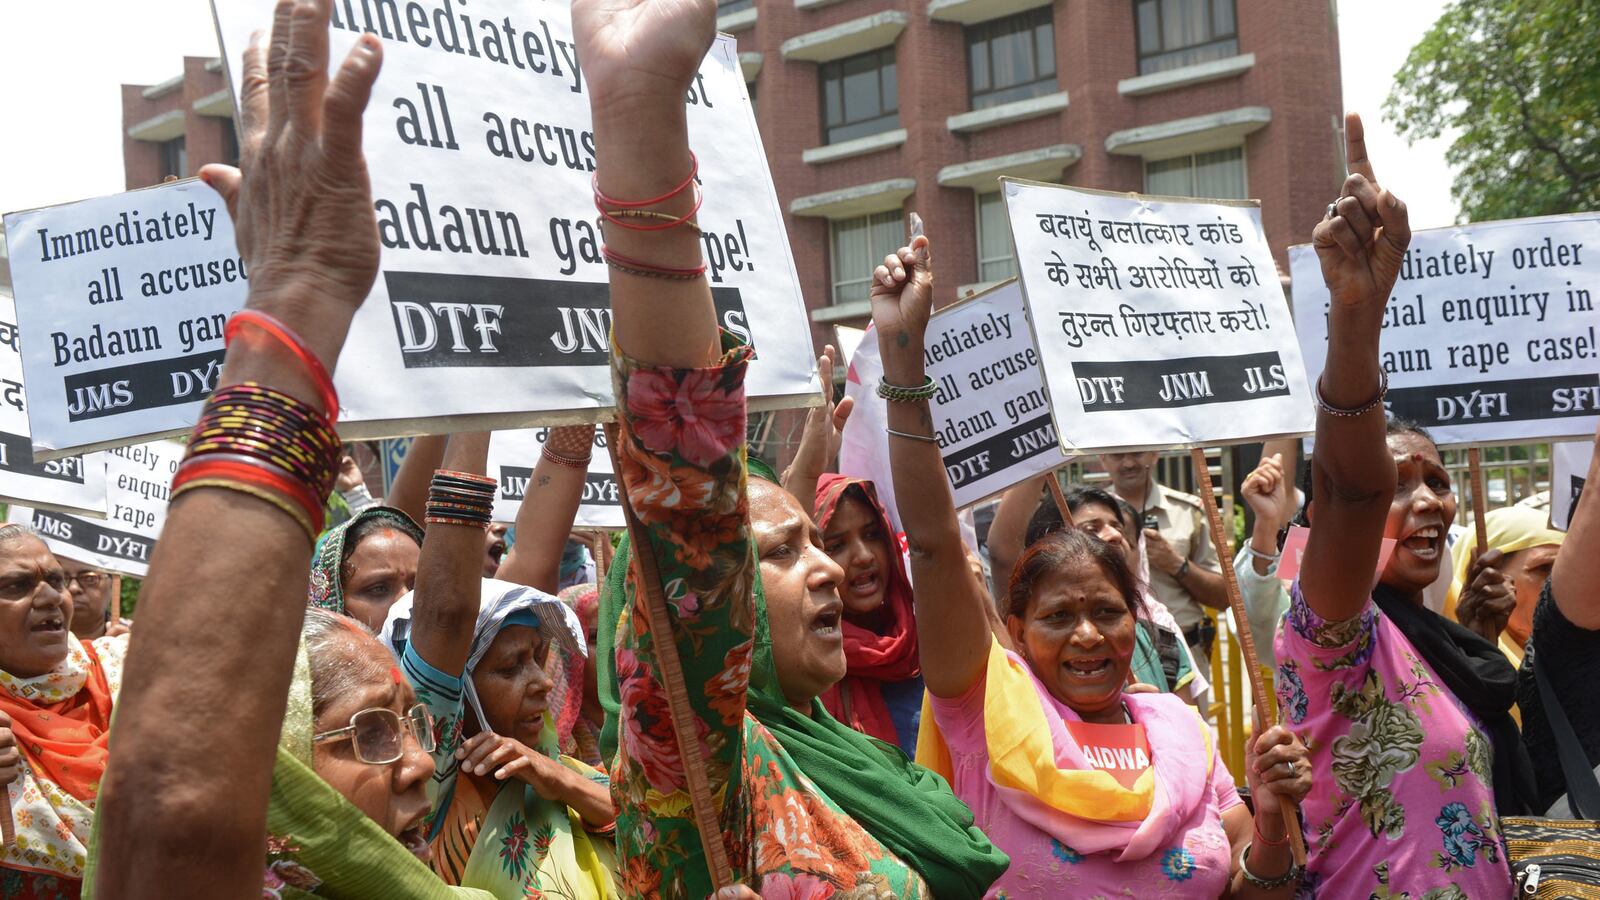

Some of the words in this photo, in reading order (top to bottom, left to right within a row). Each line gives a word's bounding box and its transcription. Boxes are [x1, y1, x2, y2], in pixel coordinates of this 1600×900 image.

[392, 82, 460, 151] all
[482, 109, 597, 172] accus
[37, 202, 216, 262] Immediately
[374, 183, 530, 259] adaun
[549, 216, 606, 276] ga
[702, 219, 755, 282] pe!
[1036, 209, 1102, 252] बदायूं
[1098, 220, 1193, 246] बलात्कार
[1197, 216, 1243, 244] कांड
[1044, 250, 1069, 287] के
[1073, 257, 1122, 290] सभी
[1127, 256, 1223, 289] आरोपियों
[1227, 256, 1260, 287] को
[1400, 244, 1495, 281] diately
[1512, 237, 1583, 270] order
[87, 266, 123, 305] all
[1442, 285, 1550, 326] enquiry
[1566, 281, 1593, 312] in
[51, 324, 162, 367] Badaun
[178, 311, 237, 353] gan
[391, 301, 505, 354] DTF
[549, 307, 611, 354] JN
[1059, 311, 1118, 348] तुरन्त
[1217, 299, 1270, 333] करो!
[1383, 347, 1432, 374] aun
[1448, 341, 1510, 374] rape
[1527, 326, 1598, 363] case!
[68, 379, 134, 415] JMS
[935, 375, 962, 405] all
[968, 347, 1038, 391] accuse
[1076, 376, 1125, 405] DTF
[1159, 371, 1214, 402] JNM
[1242, 364, 1287, 395] JLS
[1436, 389, 1510, 421] DYFI
[1552, 386, 1600, 412] SFI
[935, 409, 997, 449] adaun
[947, 450, 992, 485] DTF
[1010, 424, 1057, 459] JNM
[117, 473, 173, 501] enqui
[581, 479, 620, 501] DYF
[32, 514, 72, 540] JMS
[97, 534, 148, 560] DYFI
[113, 503, 155, 528] rape
[1082, 745, 1150, 769] AIDWA
